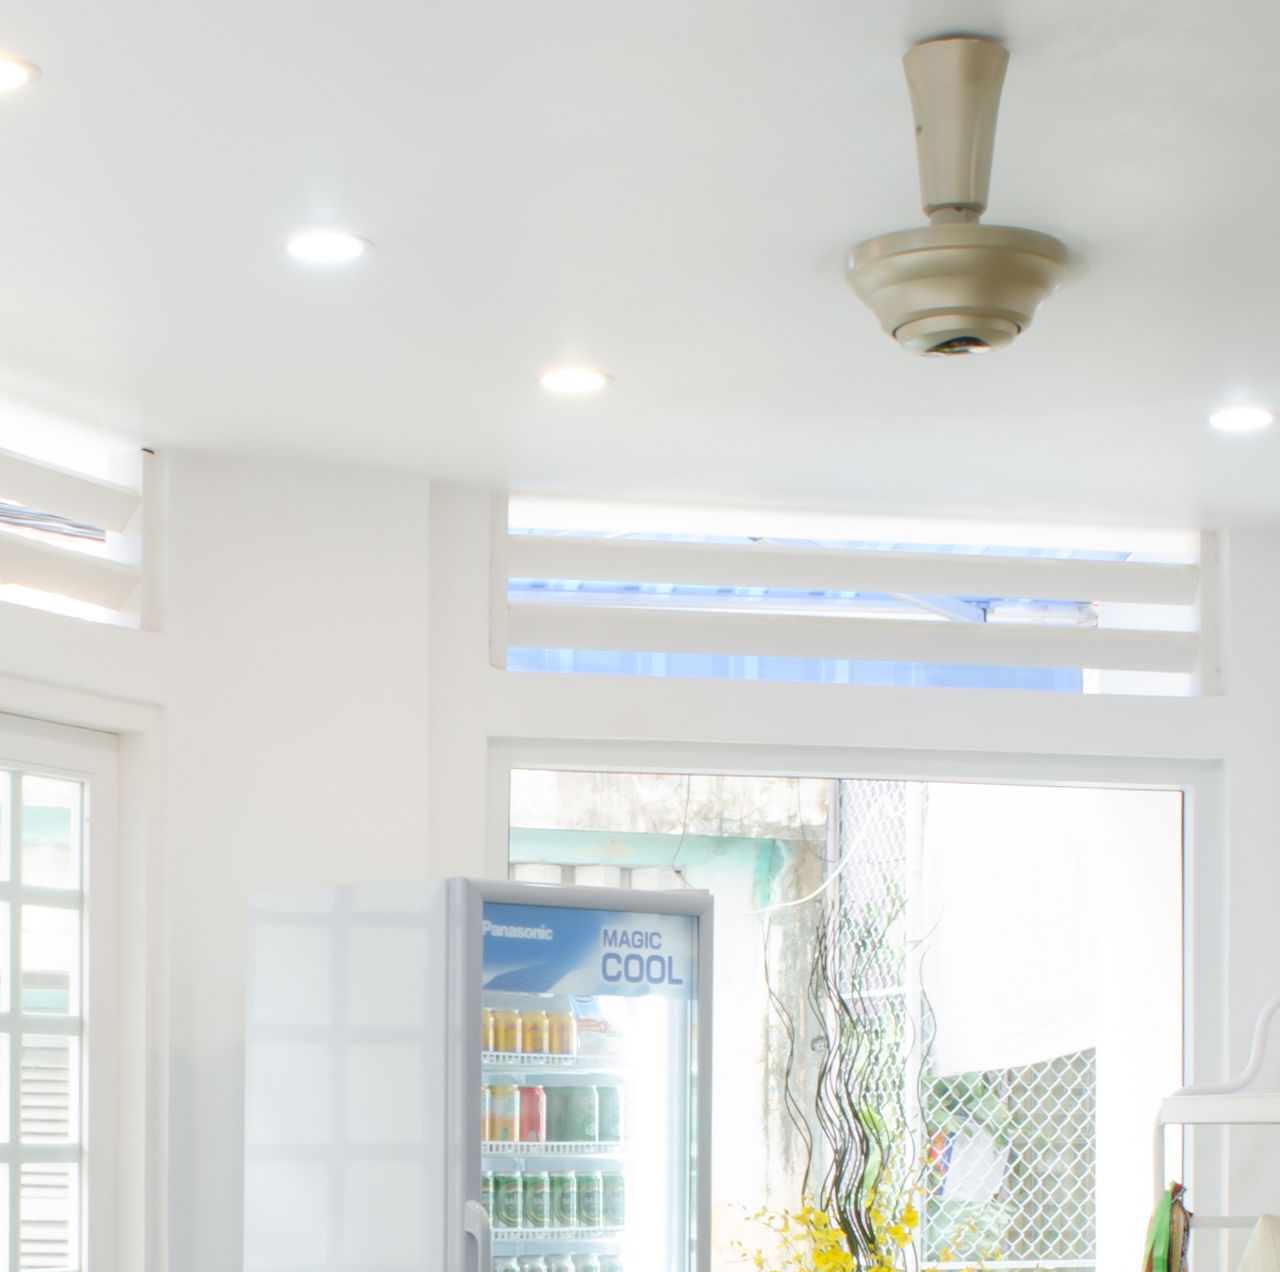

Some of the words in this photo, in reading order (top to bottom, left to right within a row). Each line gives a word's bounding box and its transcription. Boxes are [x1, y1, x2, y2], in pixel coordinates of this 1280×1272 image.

[482, 919, 553, 941] Panasonic
[602, 929, 662, 950] MAGIC
[601, 952, 684, 985] COOL
